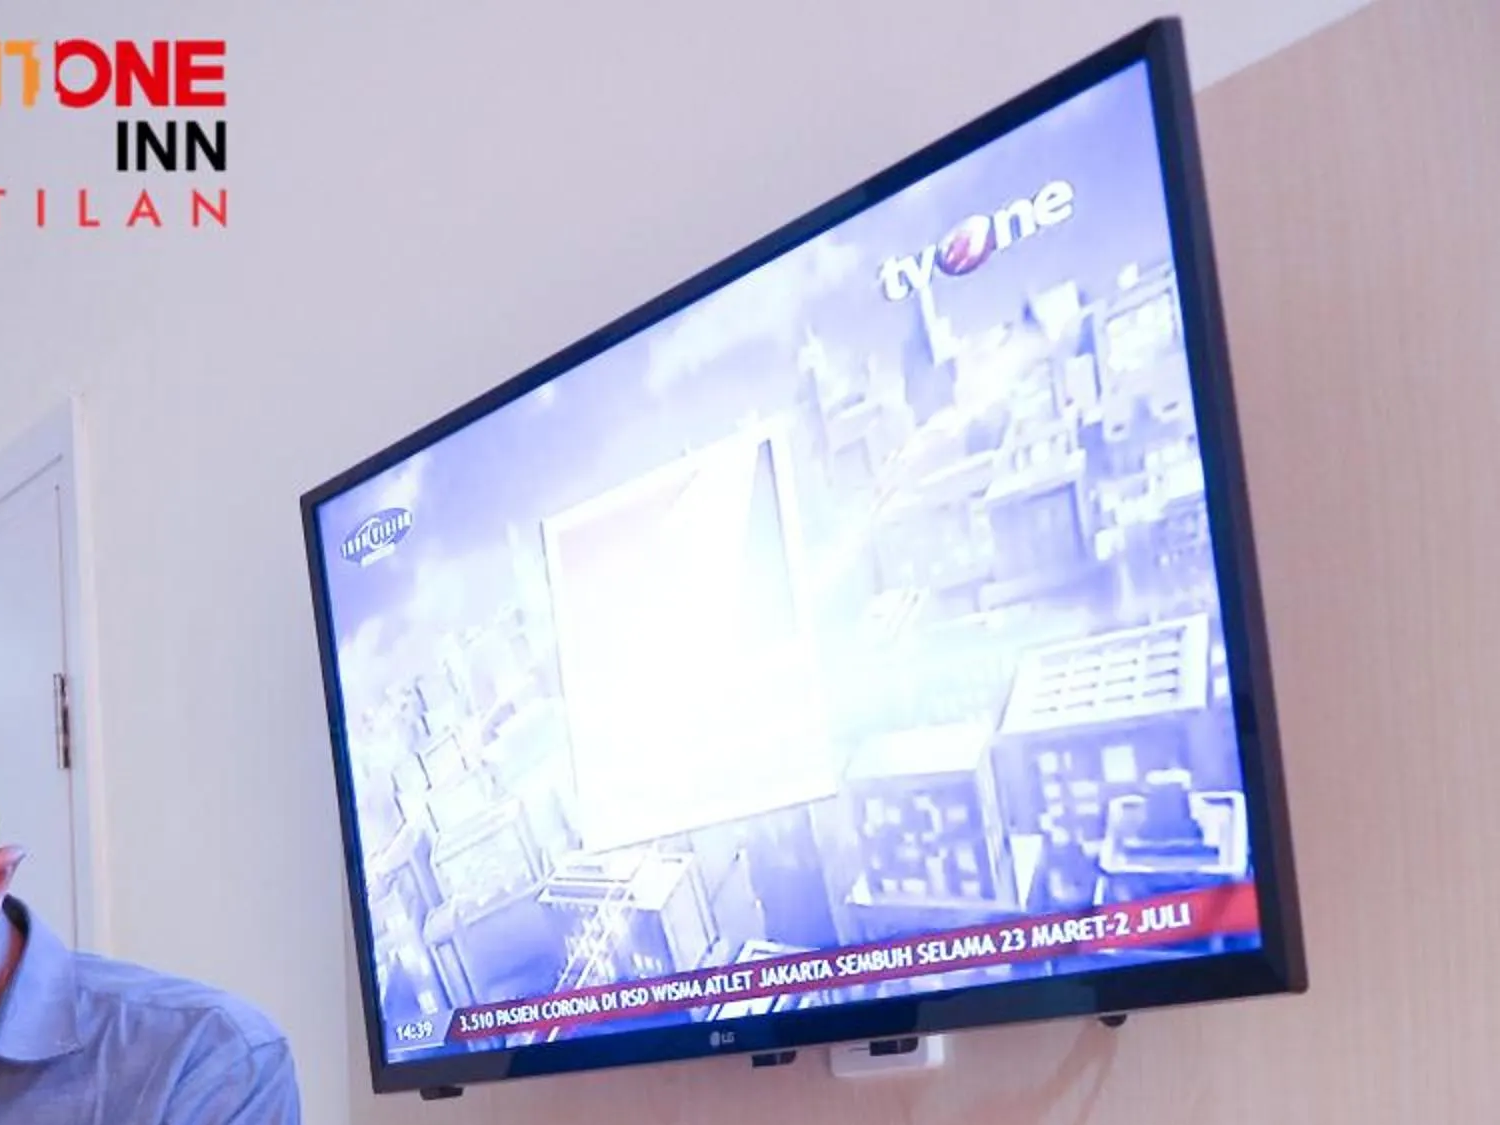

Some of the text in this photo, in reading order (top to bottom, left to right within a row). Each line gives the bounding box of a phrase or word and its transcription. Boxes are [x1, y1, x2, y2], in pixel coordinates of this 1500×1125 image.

[459, 901, 1192, 1033] 3.510 PASIEN CORONA DI RSD WISMA ATLET JAKARTA SEMBUH SELAMA 23 MARET-2 JULI
[395, 1019, 433, 1041] 14:39
[721, 1031, 735, 1044] LG
